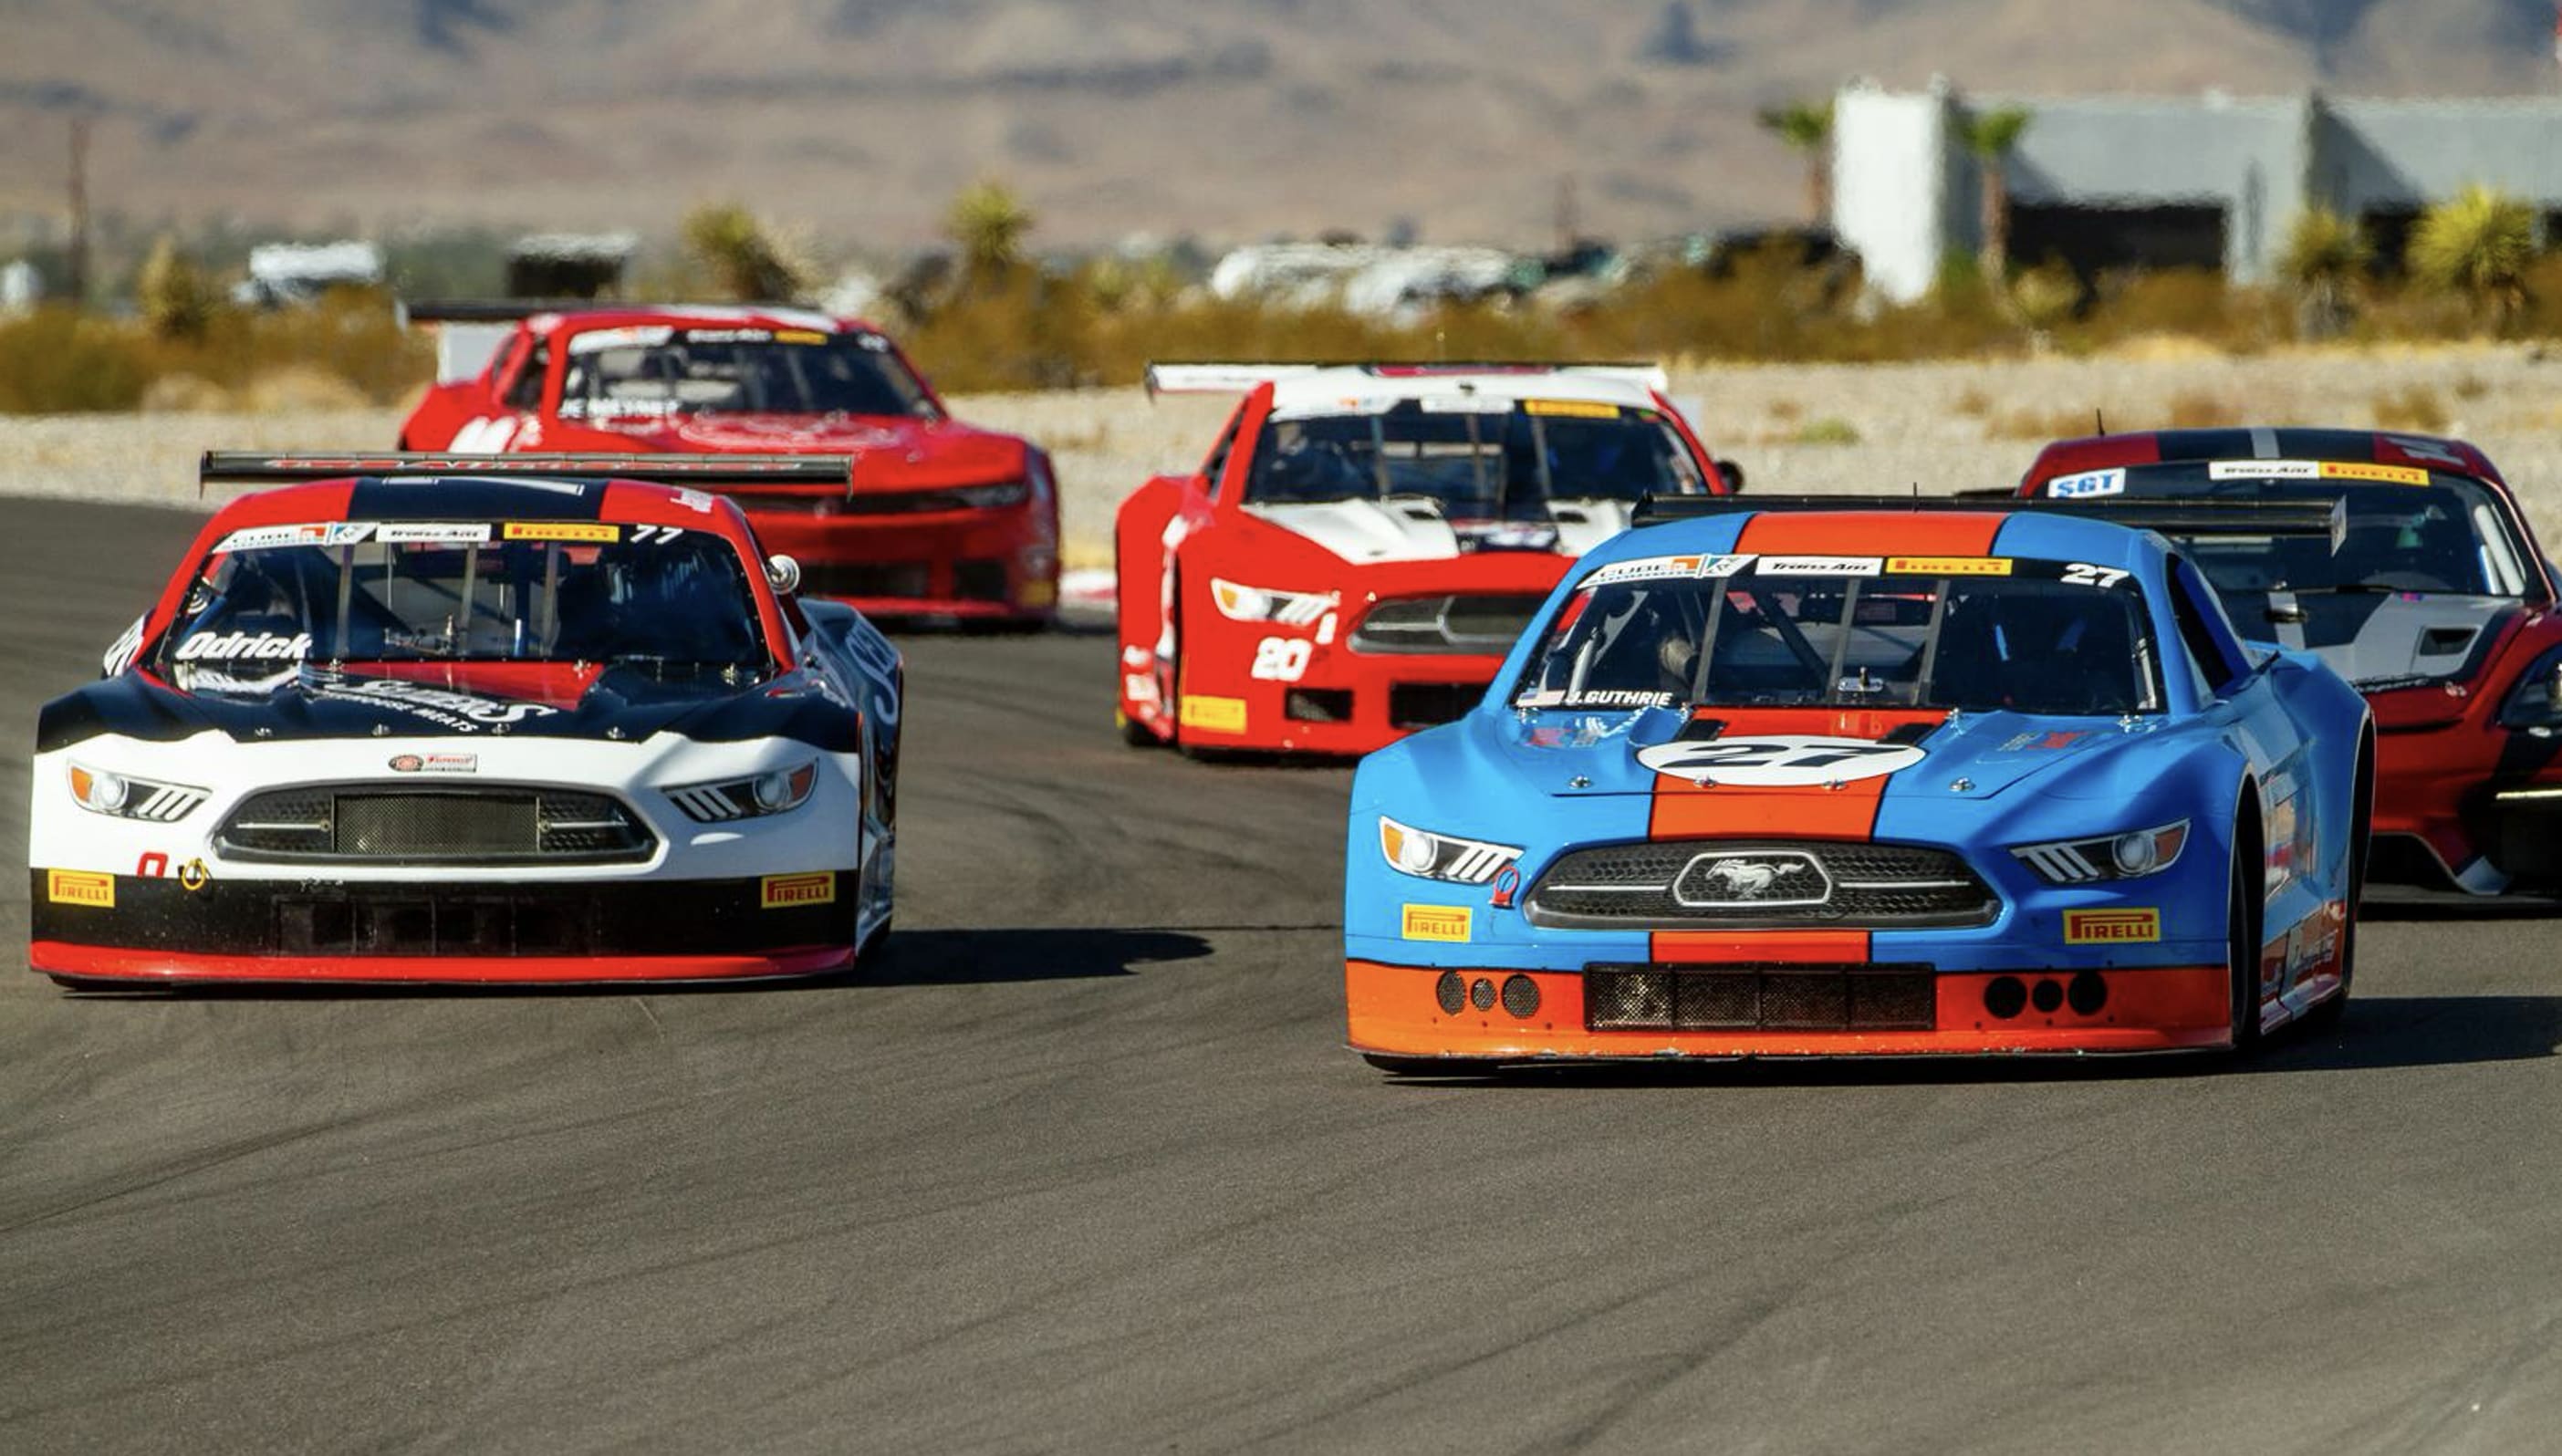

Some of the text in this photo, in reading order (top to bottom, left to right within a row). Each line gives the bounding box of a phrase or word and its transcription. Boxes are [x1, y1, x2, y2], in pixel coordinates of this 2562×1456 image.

[2056, 471, 2118, 497] SGT
[2328, 466, 2421, 481] PIRELLI
[512, 525, 610, 538] PIRELLI
[630, 524, 683, 545] 77
[1772, 562, 1873, 572] Trans Am
[1895, 559, 2003, 572] PIRELLI
[2060, 563, 2129, 588] 27
[175, 631, 313, 660] Odrick
[1251, 637, 1313, 681] 20
[1566, 691, 1673, 705] J.GUTHRIE
[1672, 743, 1909, 768] 27
[55, 875, 108, 900] PIRELLI
[766, 875, 829, 902] PIRELLI
[1408, 911, 1466, 935] PIRELLI
[2069, 912, 2154, 940] PIRELLI
